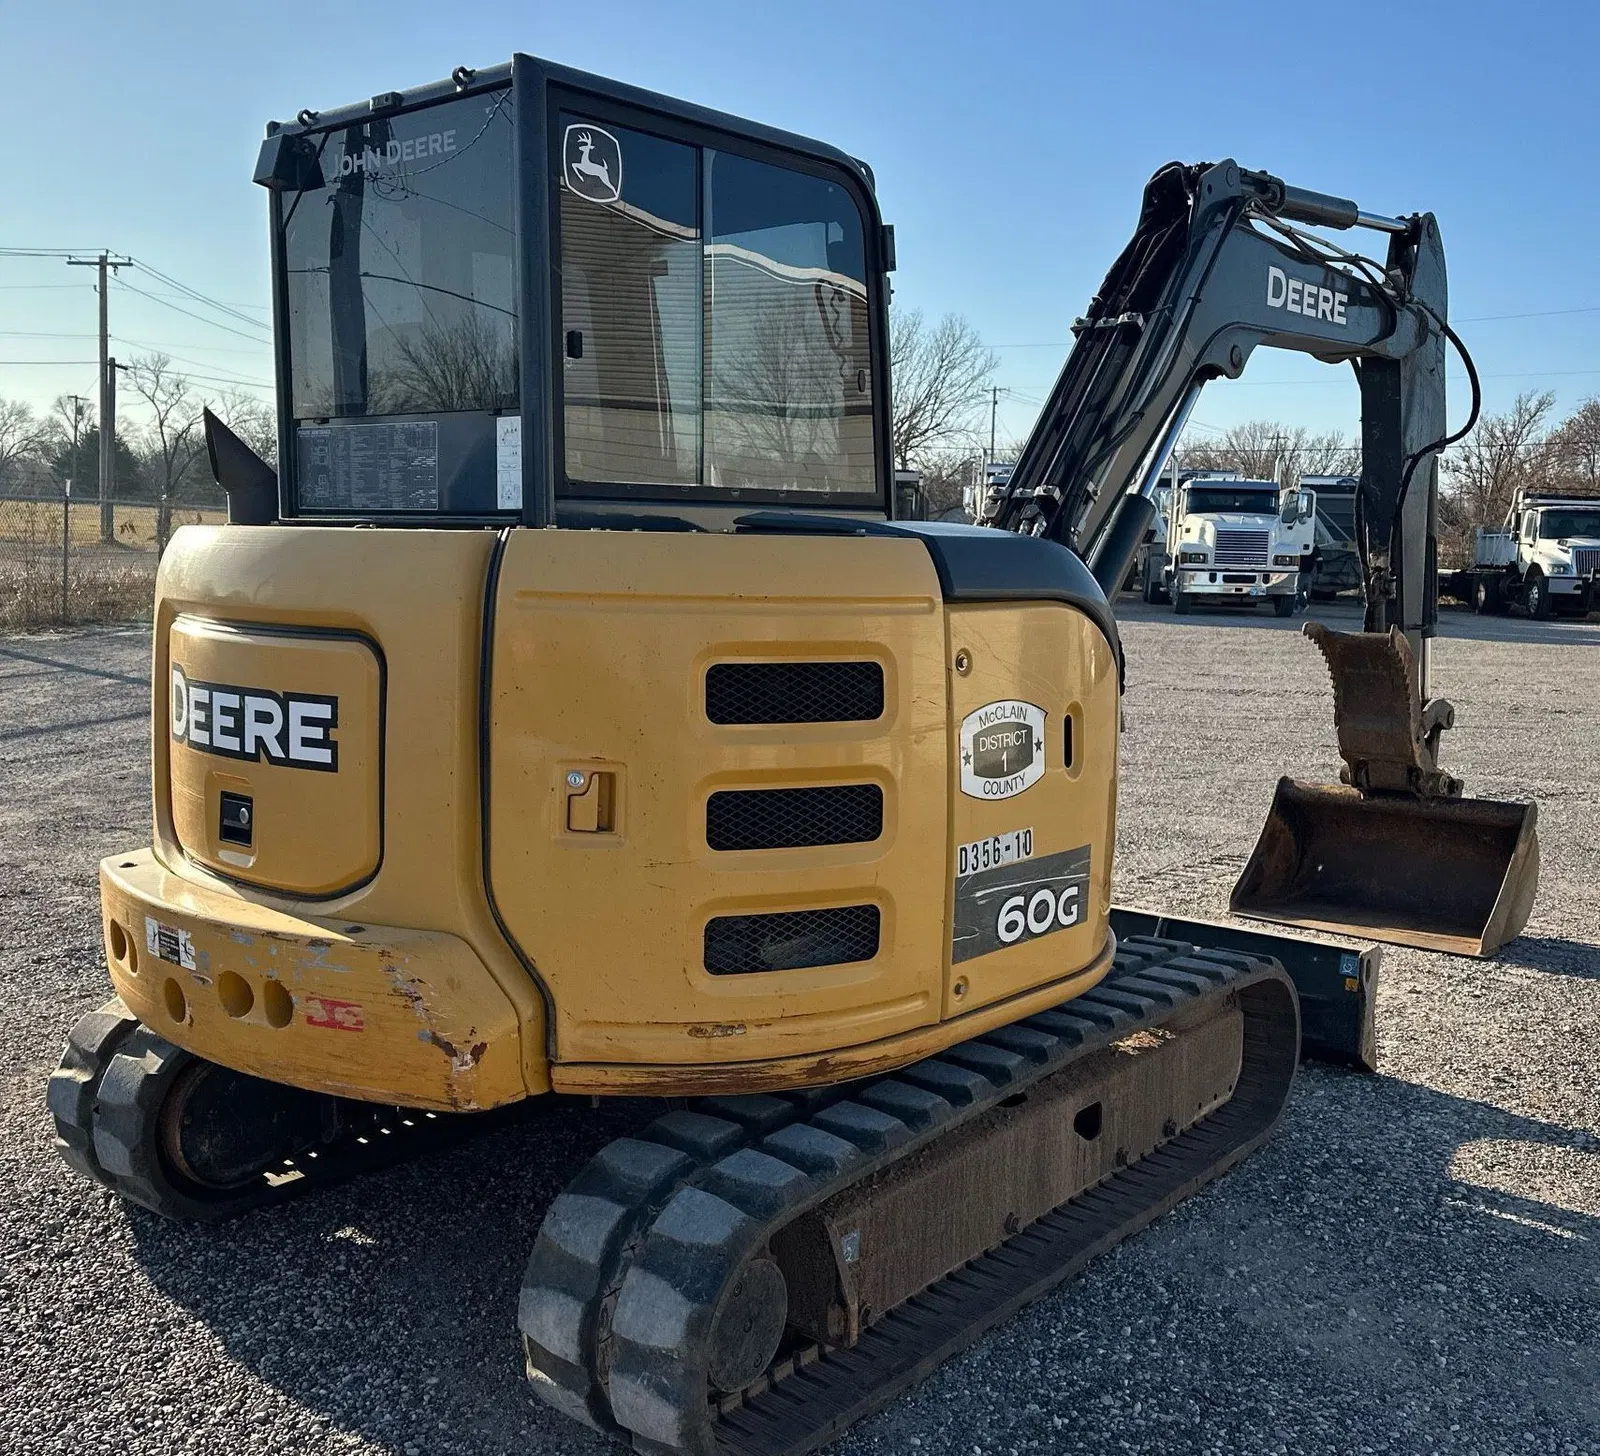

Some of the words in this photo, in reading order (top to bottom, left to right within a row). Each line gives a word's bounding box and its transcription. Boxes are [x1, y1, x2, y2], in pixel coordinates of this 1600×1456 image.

[386, 129, 456, 164] DEERE
[1267, 266, 1348, 325] DEERE
[172, 669, 332, 763] DEERE
[978, 705, 1027, 728] McCLAIN
[979, 730, 1027, 752] DISTRICT
[1001, 751, 1008, 772] 1
[983, 772, 1026, 795] COUNTY
[959, 829, 1032, 875] D356-10
[997, 886, 1079, 943] 60G
